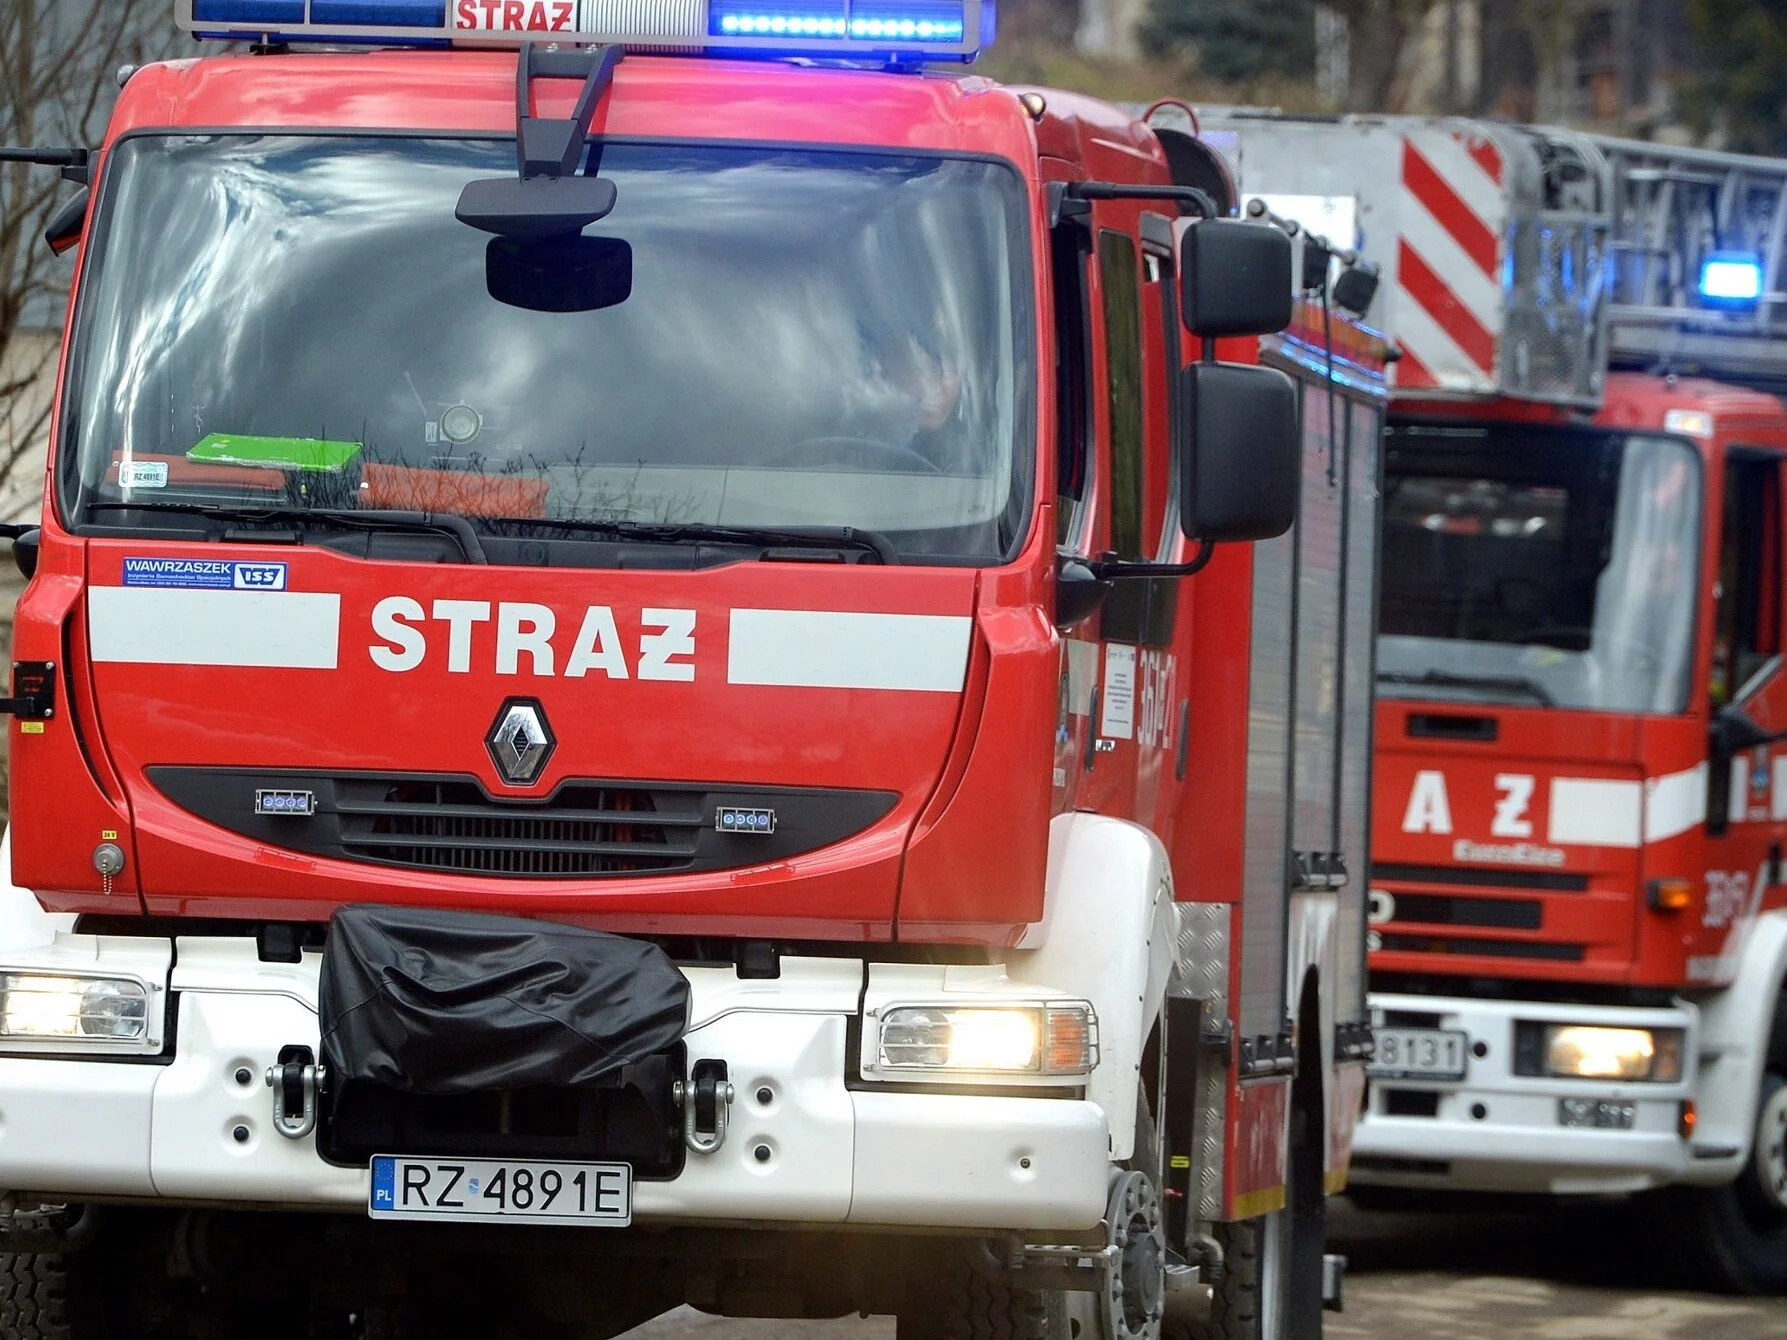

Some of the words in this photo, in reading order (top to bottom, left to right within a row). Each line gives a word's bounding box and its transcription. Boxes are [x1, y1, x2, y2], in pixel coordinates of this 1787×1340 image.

[126, 561, 231, 574] WAWRZASZEK
[368, 596, 696, 681] STRAŻ
[377, 1189, 391, 1201] PL
[403, 1164, 464, 1207] RZ
[483, 1167, 621, 1213] 4891E
